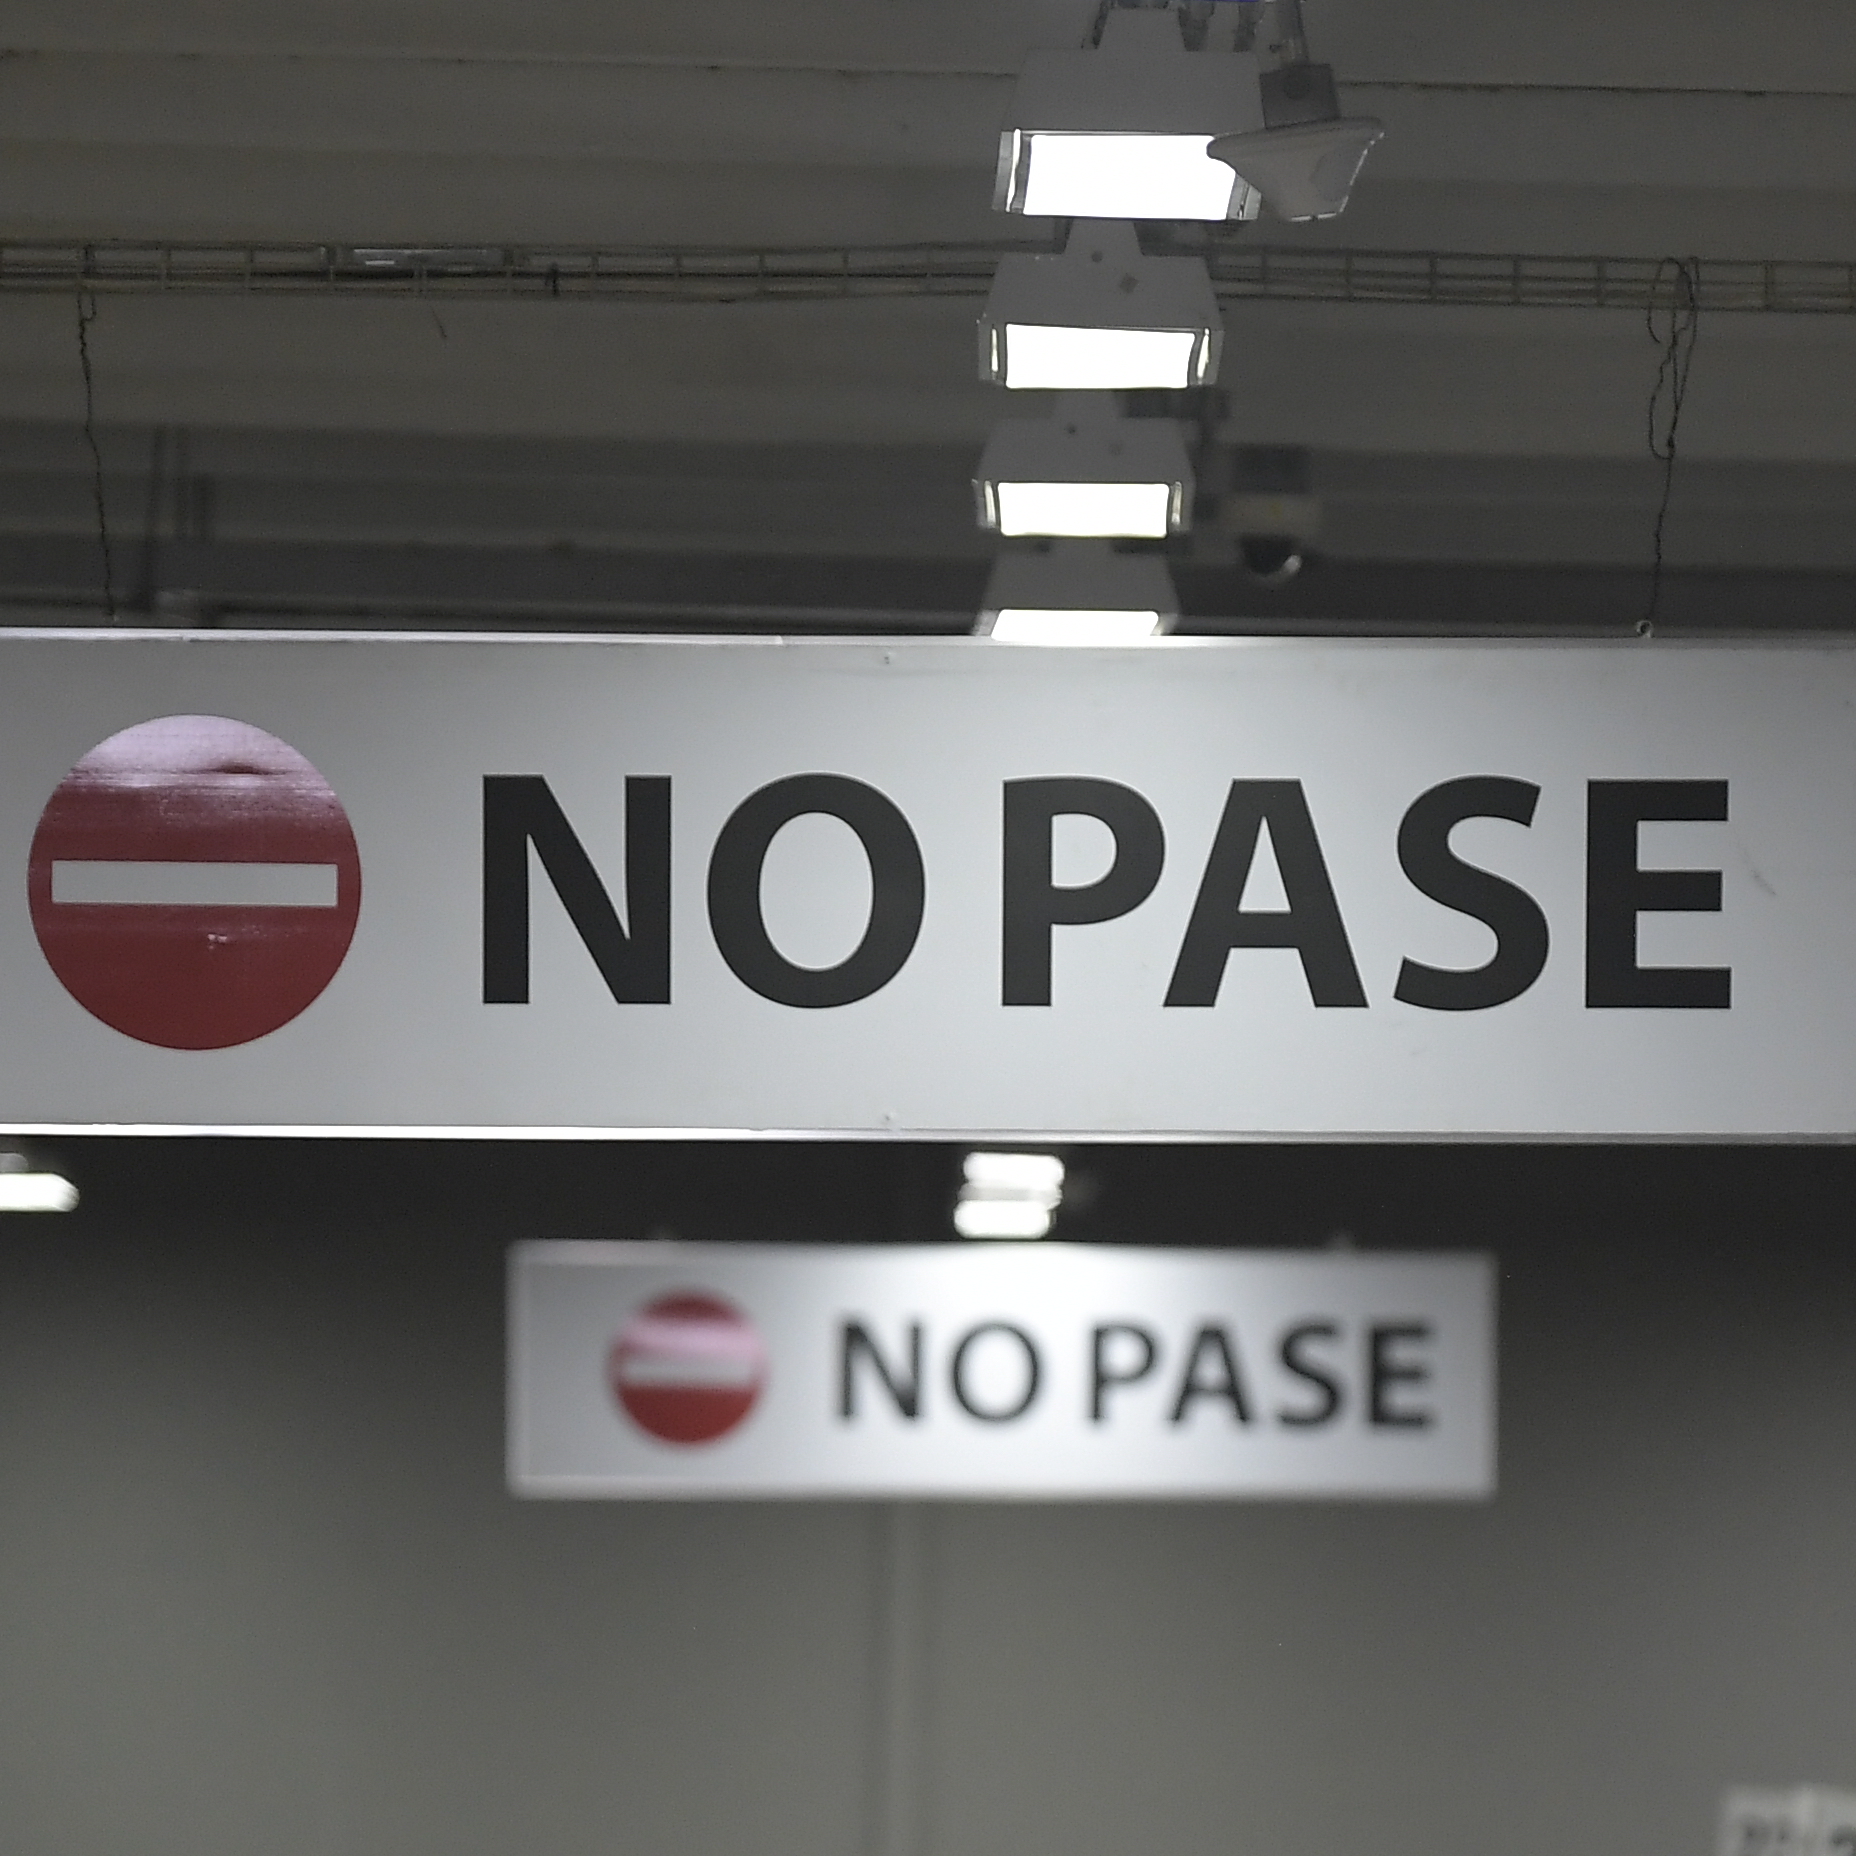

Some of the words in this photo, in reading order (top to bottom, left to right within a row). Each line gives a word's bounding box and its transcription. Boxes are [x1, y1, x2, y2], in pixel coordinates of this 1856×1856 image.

[482, 773, 926, 1010] NO
[1000, 773, 1734, 1011] PASE
[834, 1314, 1044, 1425] NO
[1087, 1318, 1436, 1430] PASE
